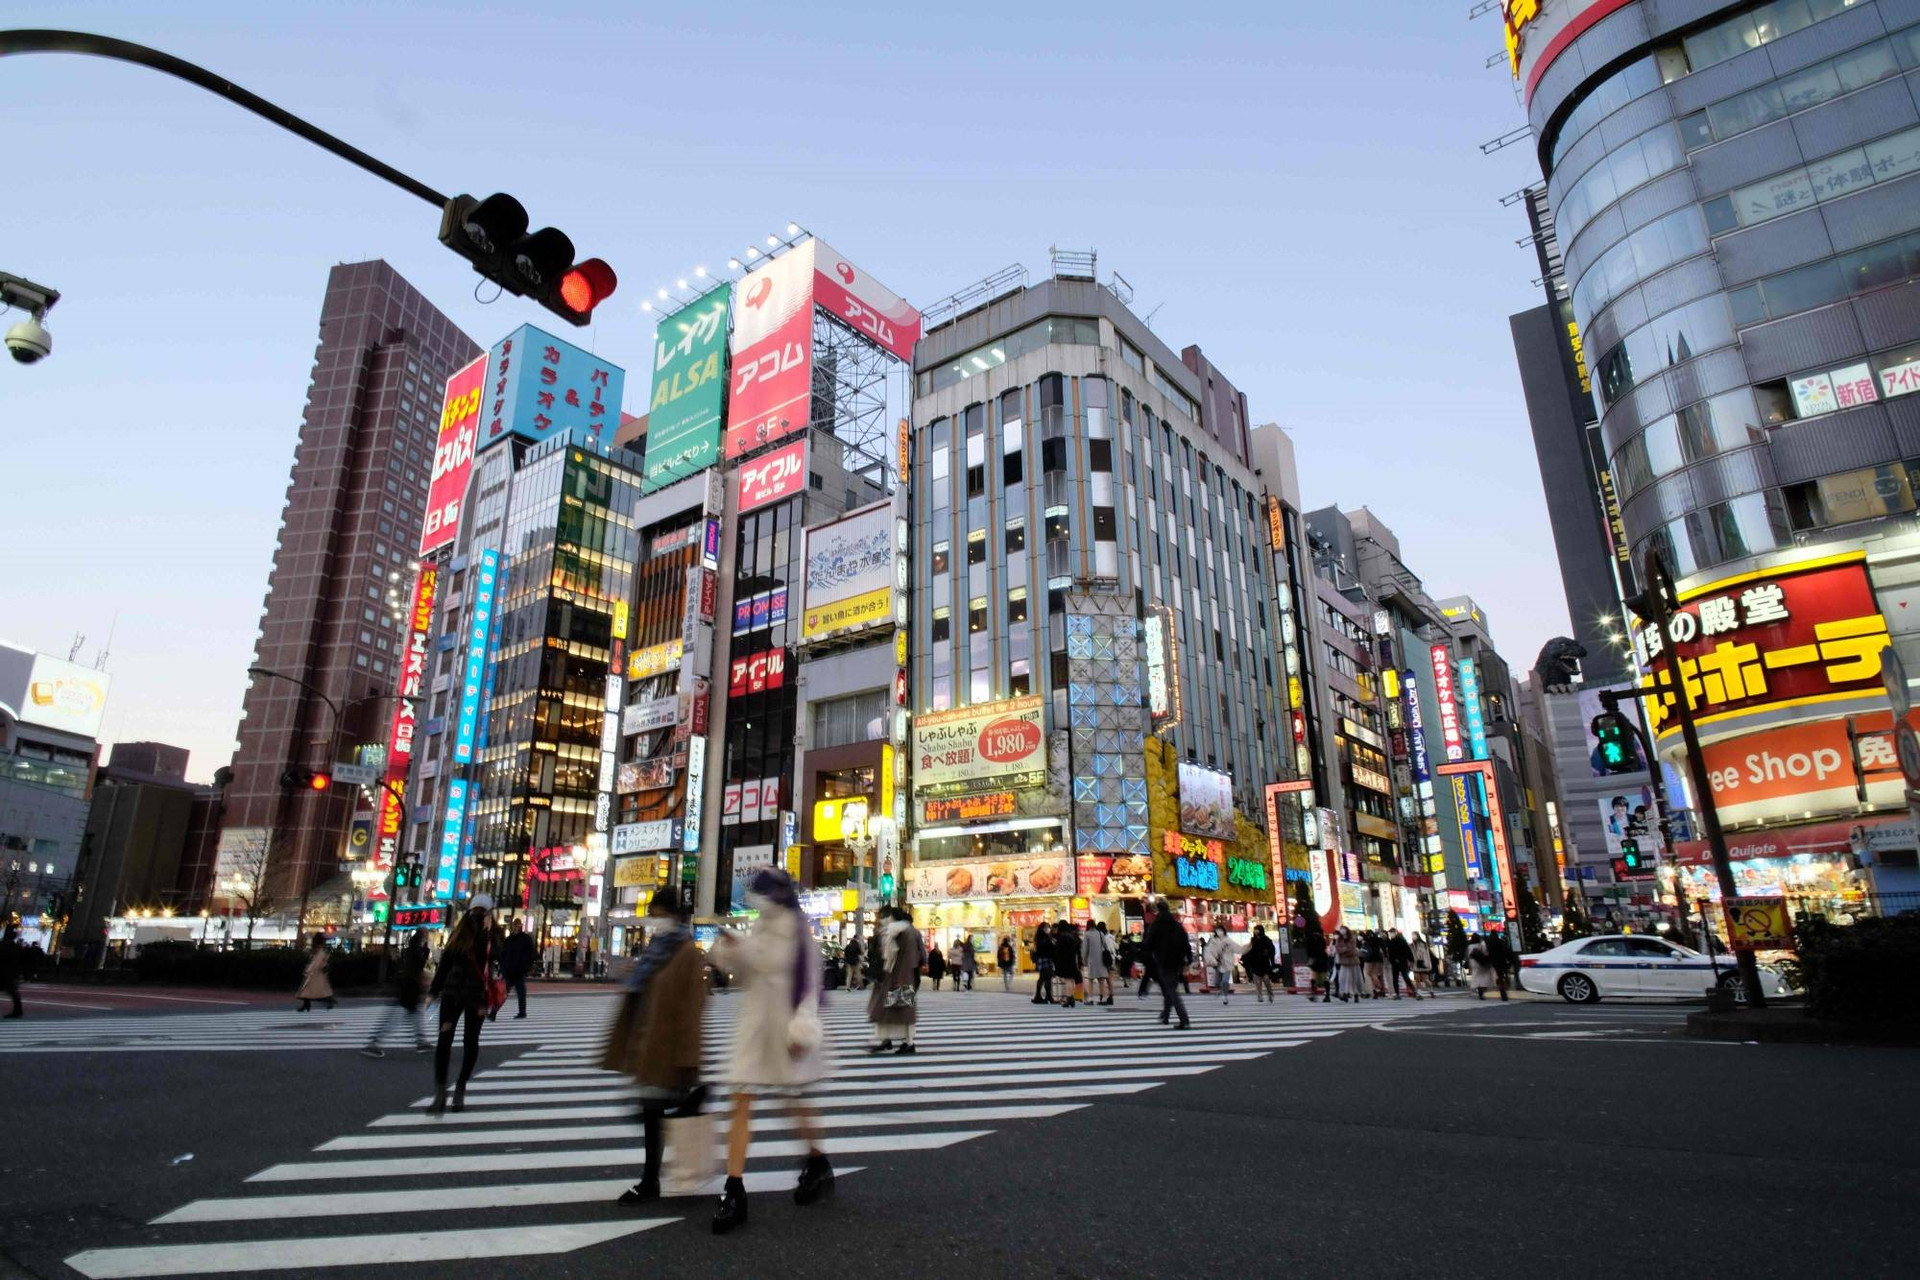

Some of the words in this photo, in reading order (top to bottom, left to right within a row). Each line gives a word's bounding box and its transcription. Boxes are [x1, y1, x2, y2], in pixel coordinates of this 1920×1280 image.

[656, 303, 728, 372] レイク
[845, 295, 894, 345] アコム
[533, 344, 561, 431] カラオケ
[651, 350, 720, 412] ALSA
[736, 341, 804, 396] アコム
[1836, 377, 1877, 407] 新宿
[431, 424, 474, 483] エスパス
[742, 453, 802, 494] アイフル
[413, 570, 437, 631] パチンコ
[400, 631, 427, 720] エスパス
[733, 653, 784, 684] アイフル
[1009, 701, 1016, 709] 2
[918, 721, 978, 744] しゃぶしゃぶ
[986, 732, 1026, 758] 1,980
[1745, 747, 1842, 785] Shop
[725, 785, 779, 813] アコム
[629, 822, 668, 836] メンズライフ
[1729, 843, 1777, 859] Quijote
